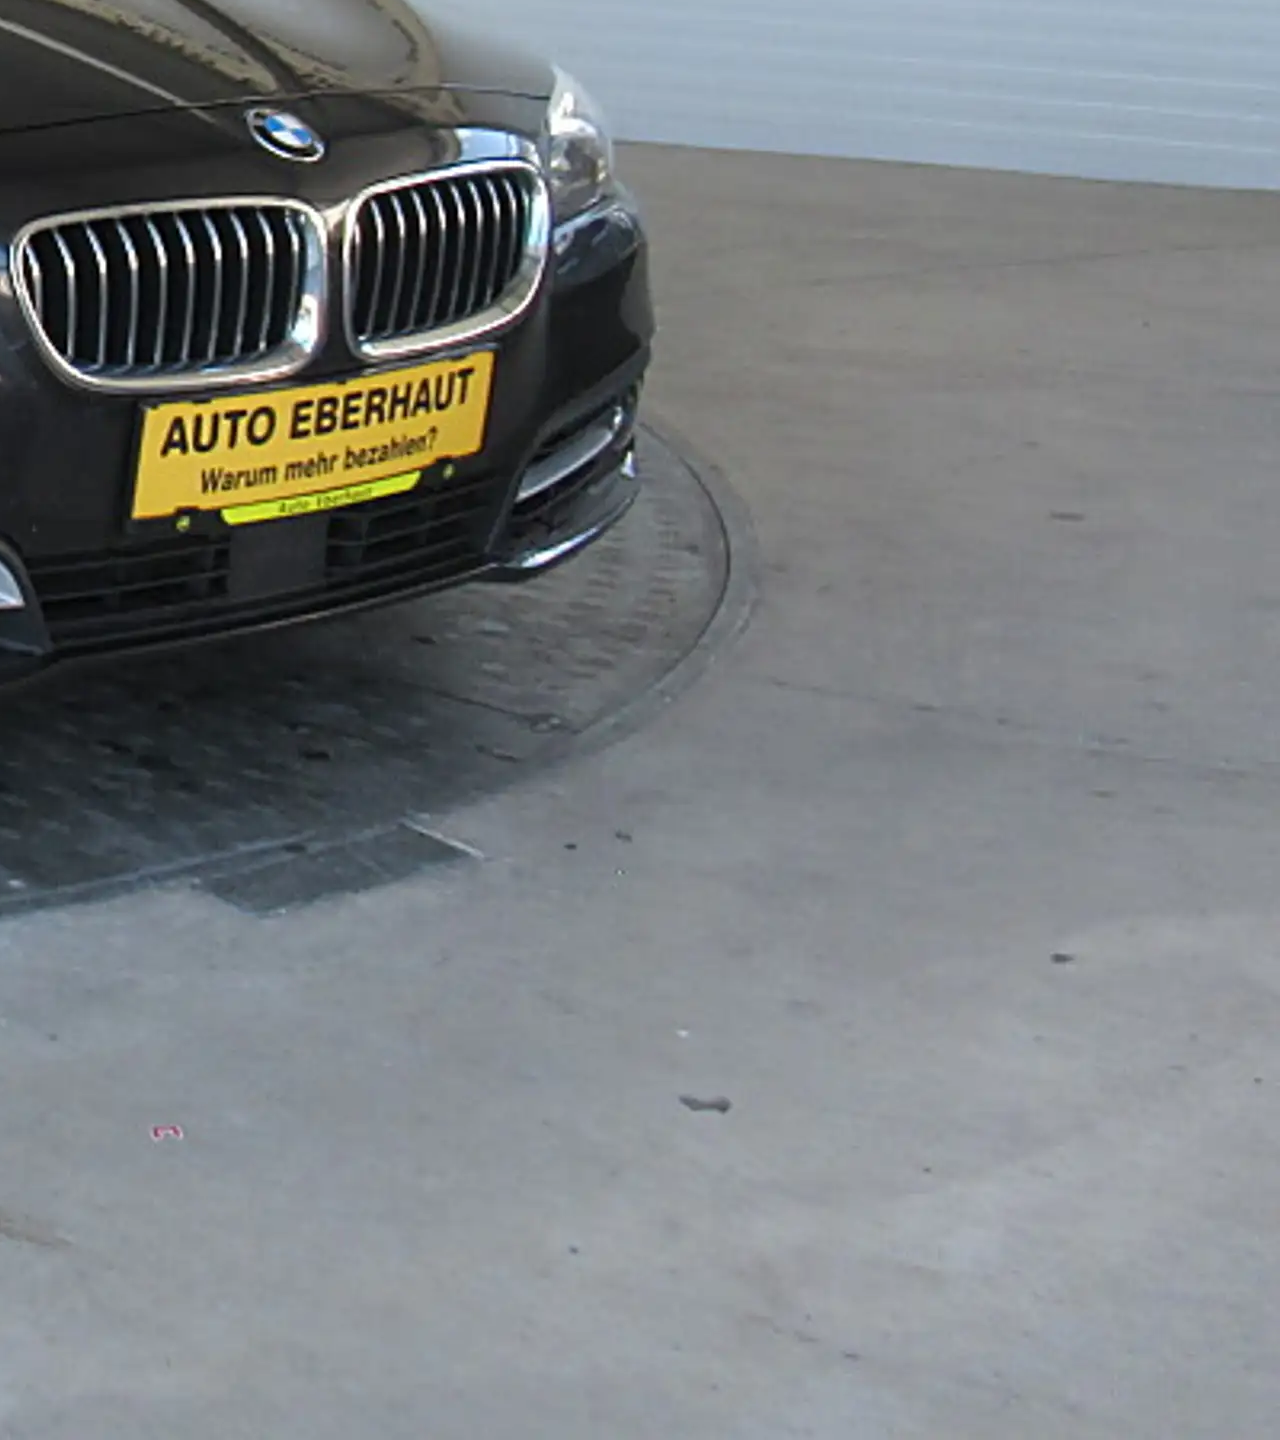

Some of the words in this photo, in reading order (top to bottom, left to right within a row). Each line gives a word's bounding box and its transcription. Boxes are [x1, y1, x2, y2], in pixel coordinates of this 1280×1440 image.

[160, 406, 275, 456] AUTO
[290, 367, 474, 440] EBERHAUT
[200, 465, 276, 495] Warum
[285, 452, 338, 481] mehr
[341, 425, 438, 470] bezahlen?
